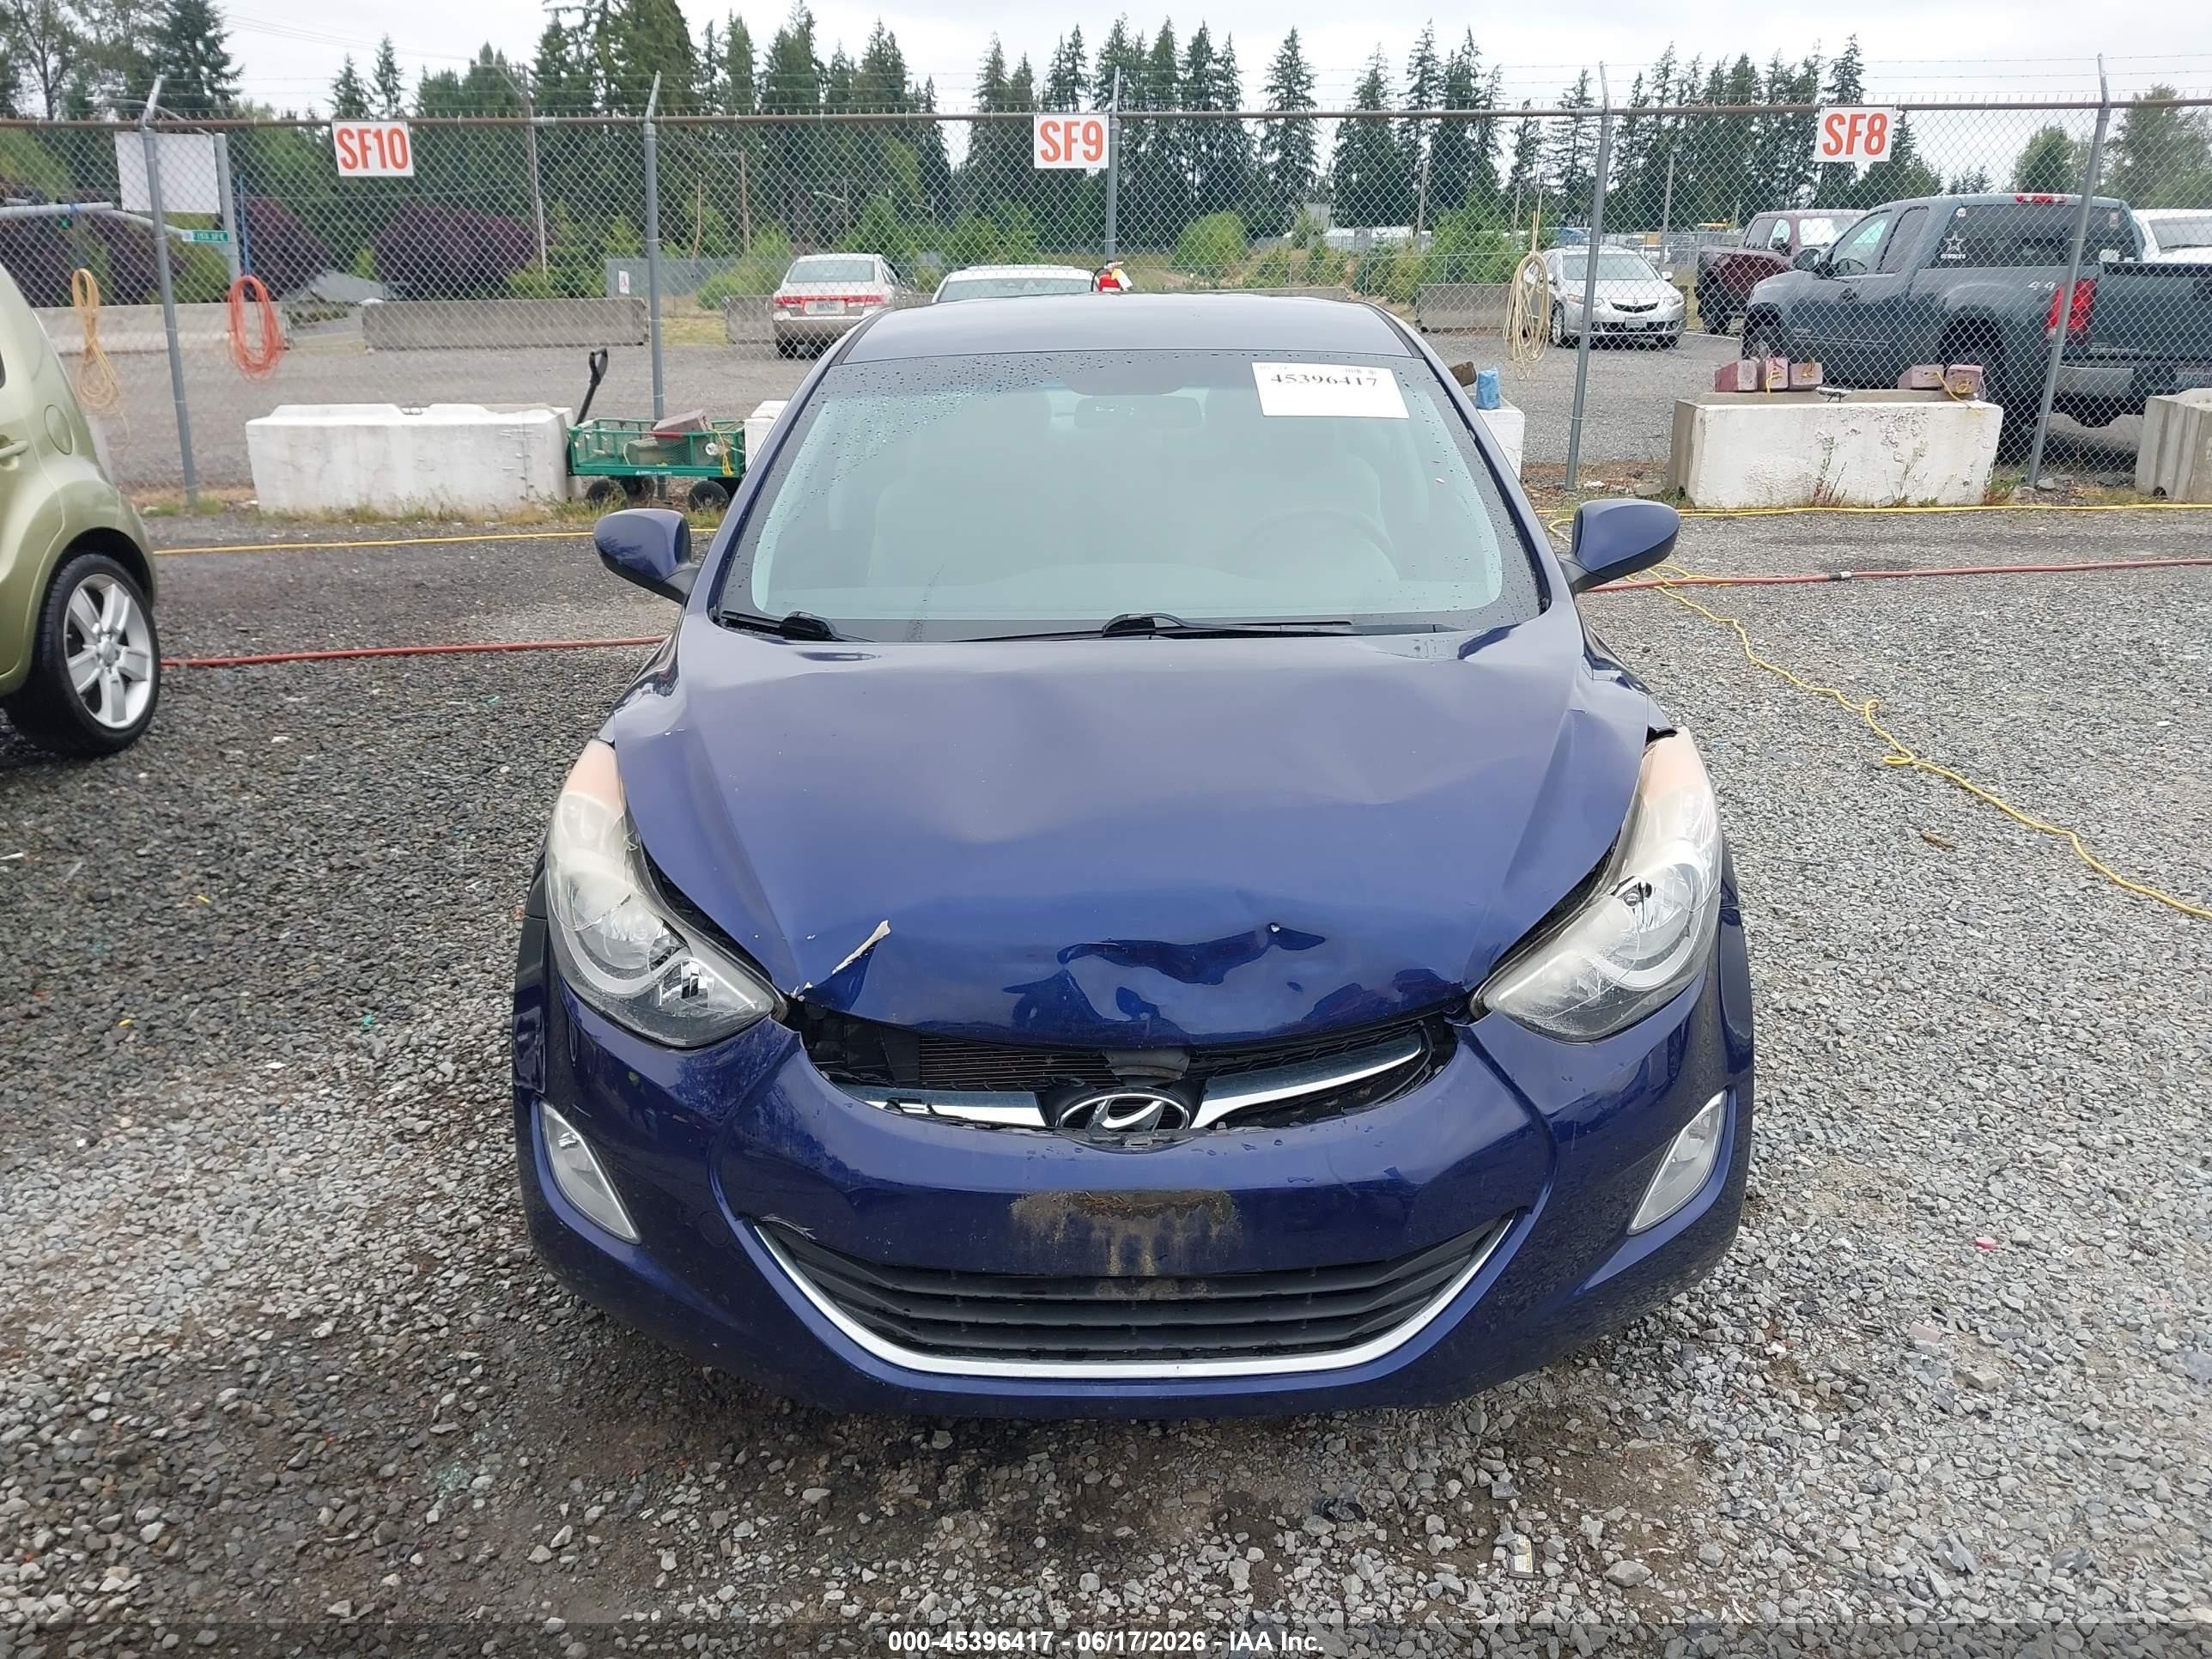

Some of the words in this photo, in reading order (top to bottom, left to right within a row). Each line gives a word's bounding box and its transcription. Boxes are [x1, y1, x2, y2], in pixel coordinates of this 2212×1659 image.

[337, 127, 408, 170] SF10
[1040, 120, 1103, 162] SF9
[1822, 112, 1887, 156] SF8
[1271, 374, 1377, 386] 45396417
